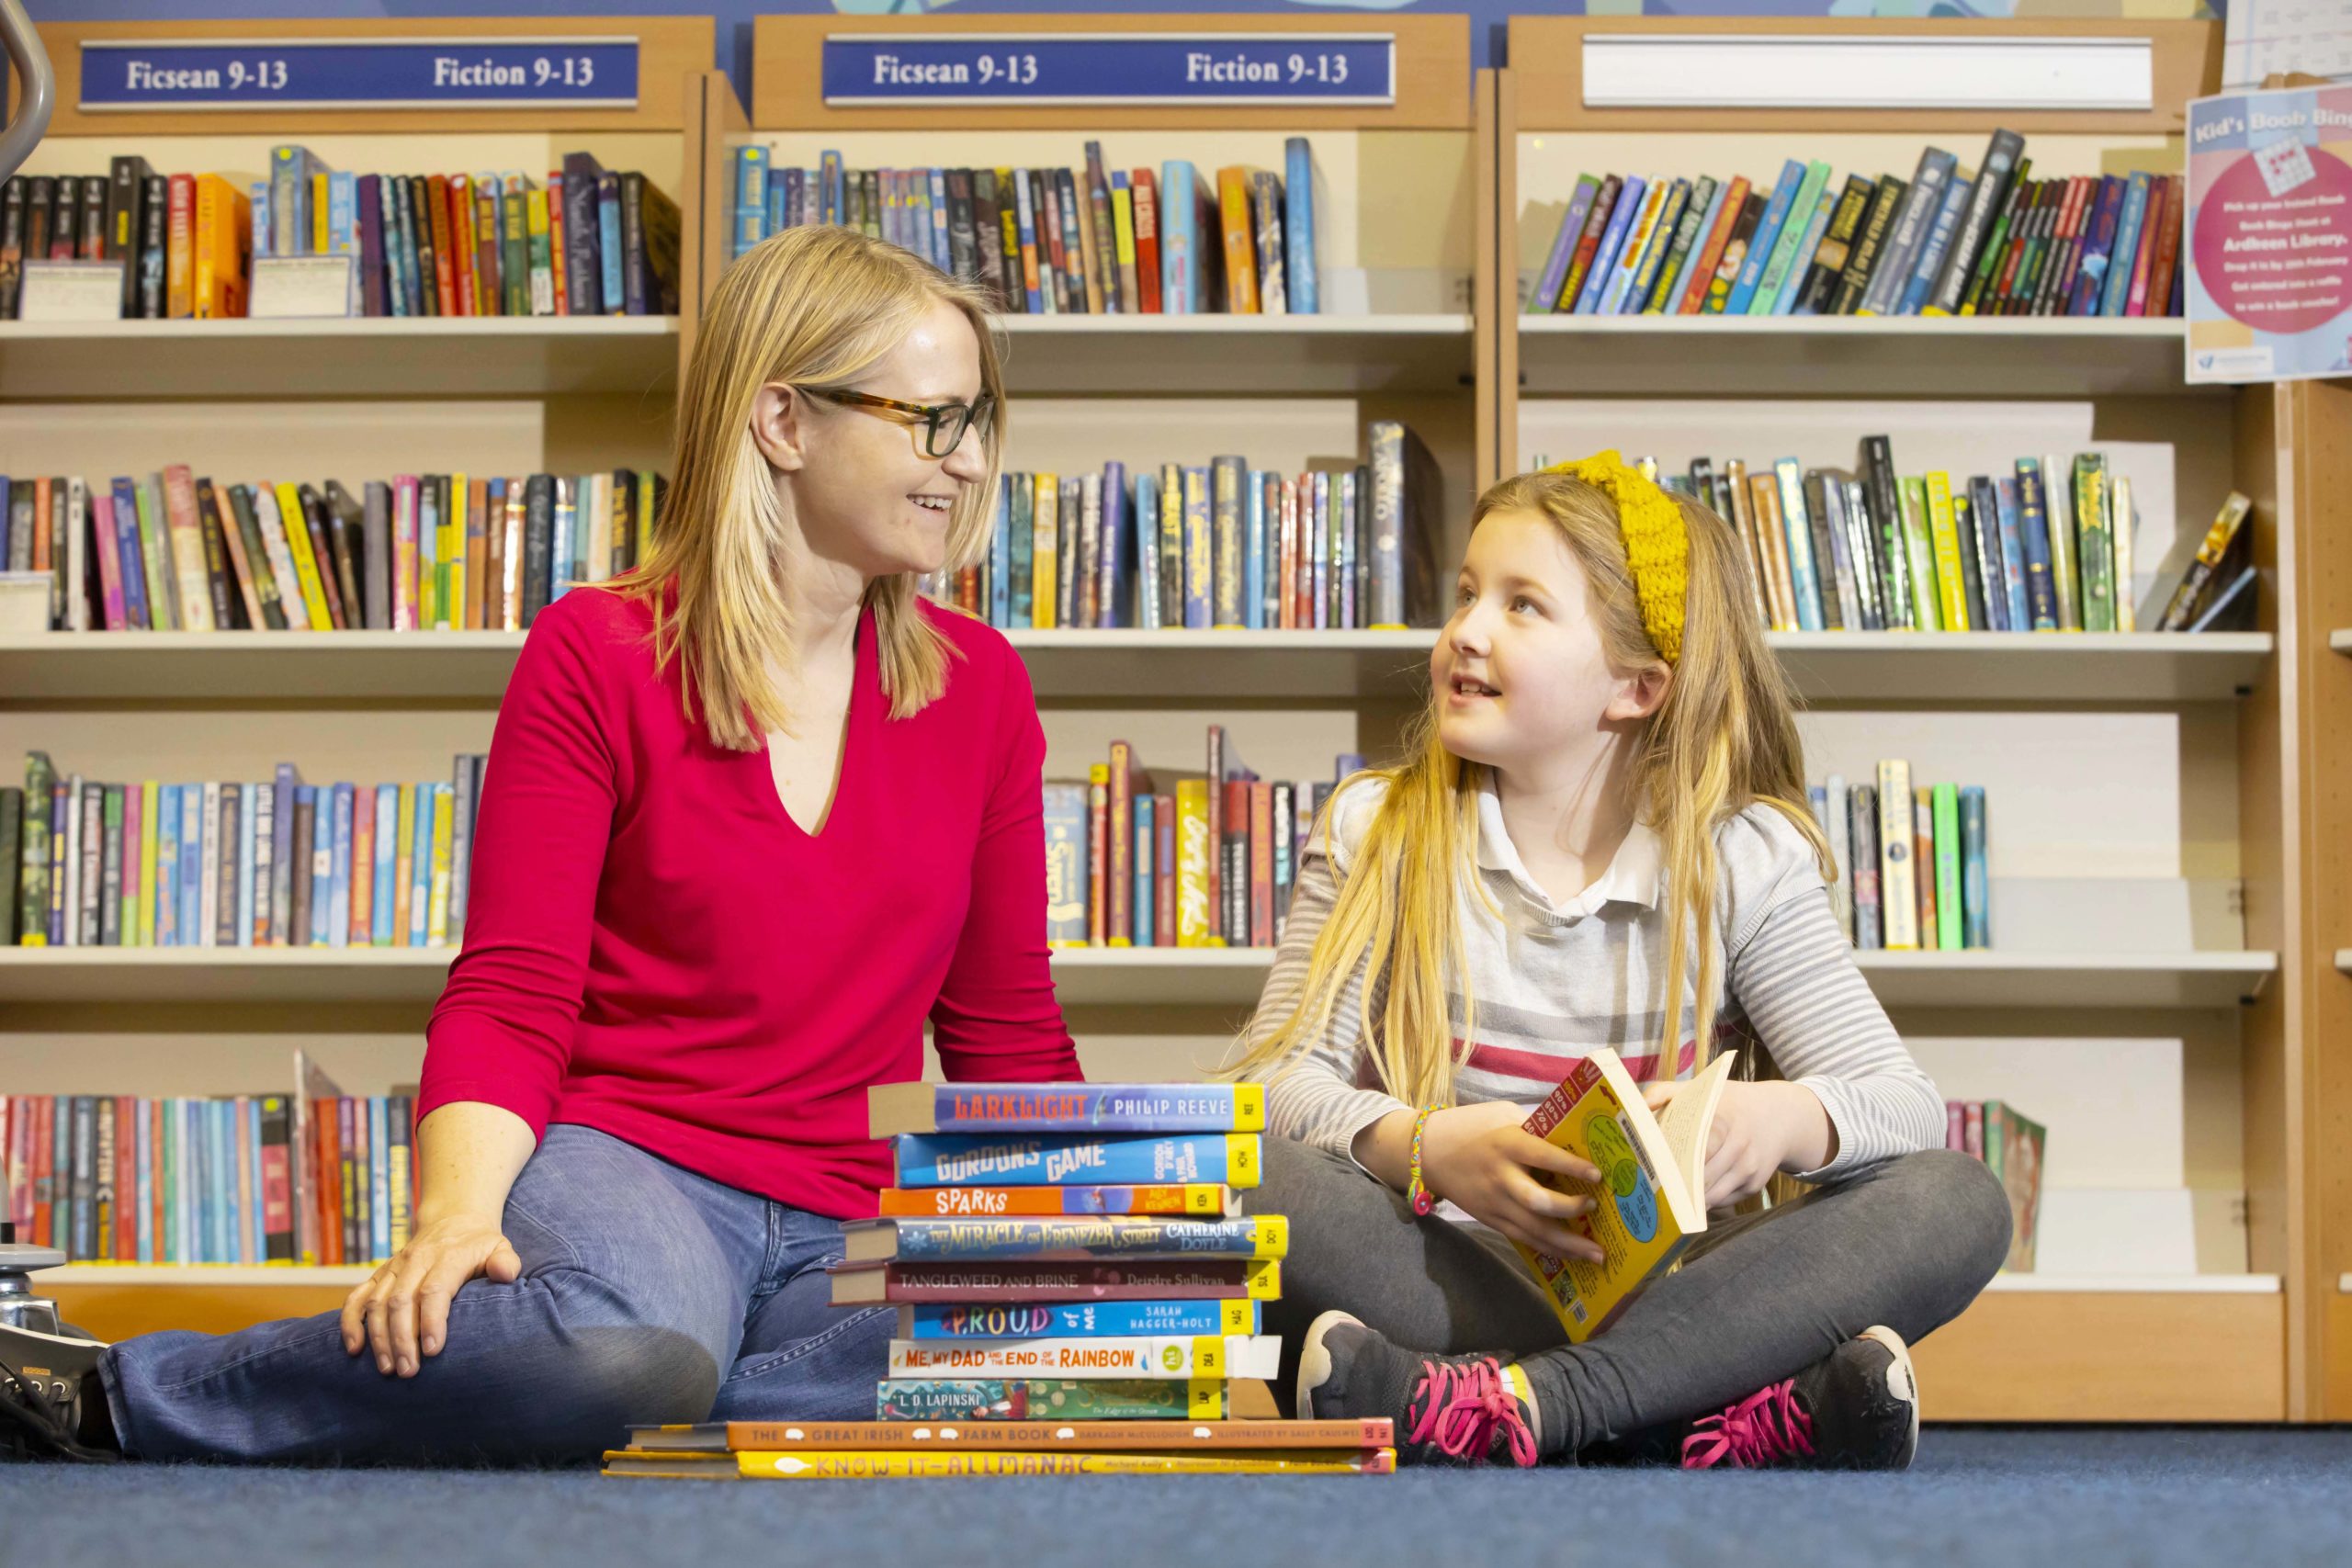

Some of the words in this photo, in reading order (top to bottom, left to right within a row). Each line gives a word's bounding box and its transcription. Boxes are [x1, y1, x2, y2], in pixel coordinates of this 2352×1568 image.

[127, 61, 220, 90] Ficsean
[228, 61, 288, 90] 9-13
[434, 58, 526, 87] Fiction
[533, 57, 594, 87] 9-13
[874, 55, 969, 84] Ficsean
[978, 55, 1038, 85] 9-13
[1186, 53, 1280, 83] Fiction
[1287, 54, 1349, 84] 9-13
[955, 1094, 1088, 1122] LARKLIGHT
[1114, 1100, 1170, 1116] PHILIP
[1177, 1099, 1228, 1115] REEVE
[1243, 1103, 1254, 1115] REE
[1046, 1140, 1106, 1183] GAME
[1154, 1143, 1165, 1180] GORDON
[1238, 1151, 1248, 1168] HOW
[935, 1189, 1008, 1214] SPARKS
[1165, 1222, 1240, 1238] CATHERINE
[1266, 1228, 1277, 1245] DOY
[929, 1230, 949, 1244] THE
[941, 1223, 1024, 1255] MIRACLE
[1039, 1223, 1120, 1250] EBENEZER
[1120, 1226, 1161, 1248] STREET
[1180, 1236, 1228, 1251] DOYLE
[899, 1273, 1002, 1288] TANGLEWEED
[1001, 1275, 1033, 1288] AND
[1035, 1273, 1079, 1288] BRINE
[1126, 1273, 1172, 1287] Deirdre
[1174, 1272, 1227, 1287] Sullivan
[1257, 1275, 1269, 1288] SUL
[1063, 1311, 1080, 1328] of
[1145, 1306, 1182, 1317] SARAH
[1231, 1309, 1243, 1325] HAG
[1130, 1317, 1213, 1330] HAGGER-HOLT
[906, 1349, 932, 1369] ME,
[933, 1352, 950, 1366] MY
[950, 1349, 986, 1369] DAD
[988, 1351, 1002, 1359] AND
[1005, 1351, 1038, 1366] END
[1040, 1359, 1056, 1367] THE
[1042, 1351, 1054, 1359] OF
[1059, 1348, 1136, 1369] RAINBOW
[1204, 1352, 1214, 1368] DEA
[899, 1394, 910, 1407] L.
[912, 1394, 924, 1407] D.
[926, 1393, 981, 1407] LAPINSKI
[752, 1429, 779, 1441] THE
[811, 1428, 859, 1441] GREAT
[864, 1428, 904, 1441] IRISH
[962, 1428, 1003, 1441] FARM
[1008, 1428, 1052, 1441] BOOK
[1080, 1430, 1125, 1440] DARRAGH
[1216, 1430, 1274, 1439] ILLUSTRATED
[1277, 1430, 1287, 1438] BY
[1289, 1430, 1317, 1439] SALLY
[816, 1455, 1093, 1477] KNOW-IT-ALLMANAC
[1141, 1460, 1164, 1470] Kelly
